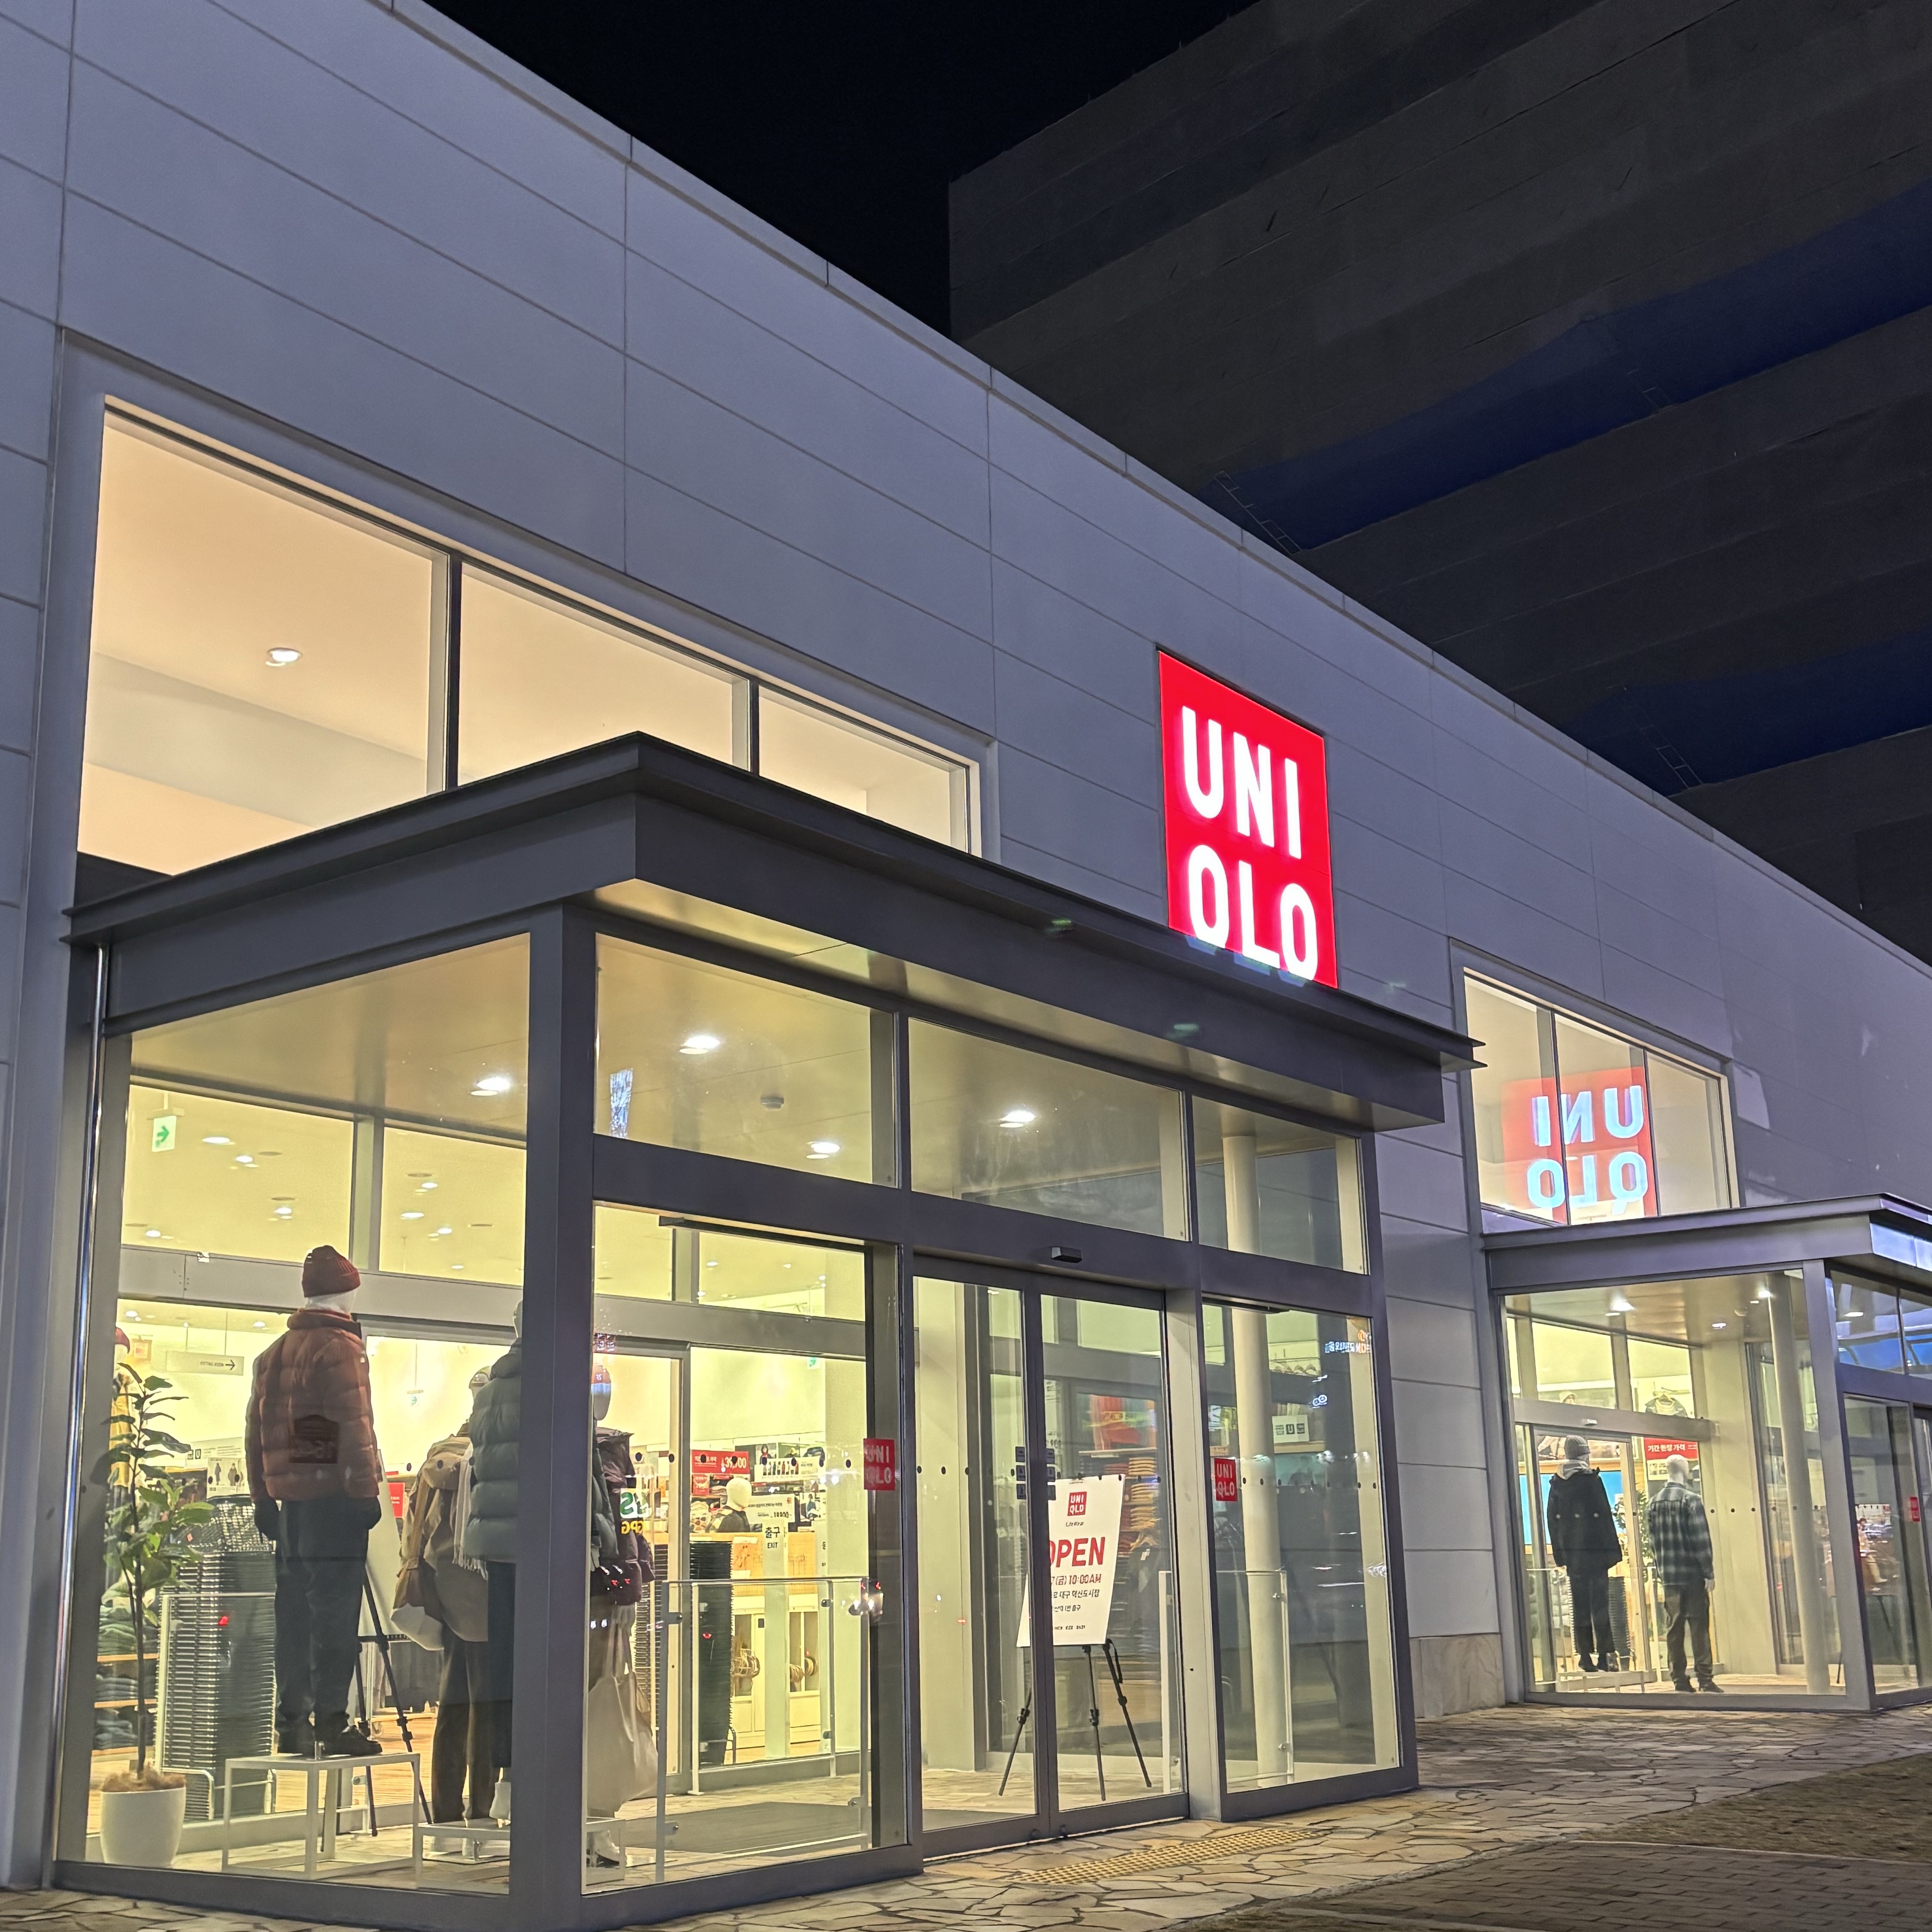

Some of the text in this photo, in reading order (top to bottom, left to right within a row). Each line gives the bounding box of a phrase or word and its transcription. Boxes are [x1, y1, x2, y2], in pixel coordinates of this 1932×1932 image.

[1182, 705, 1302, 860] UNI
[1216, 1463, 1232, 1479] UNI
[1217, 1481, 1235, 1498] QLO
[1071, 1494, 1084, 1503] UNI
[765, 1527, 780, 1538] 출구
